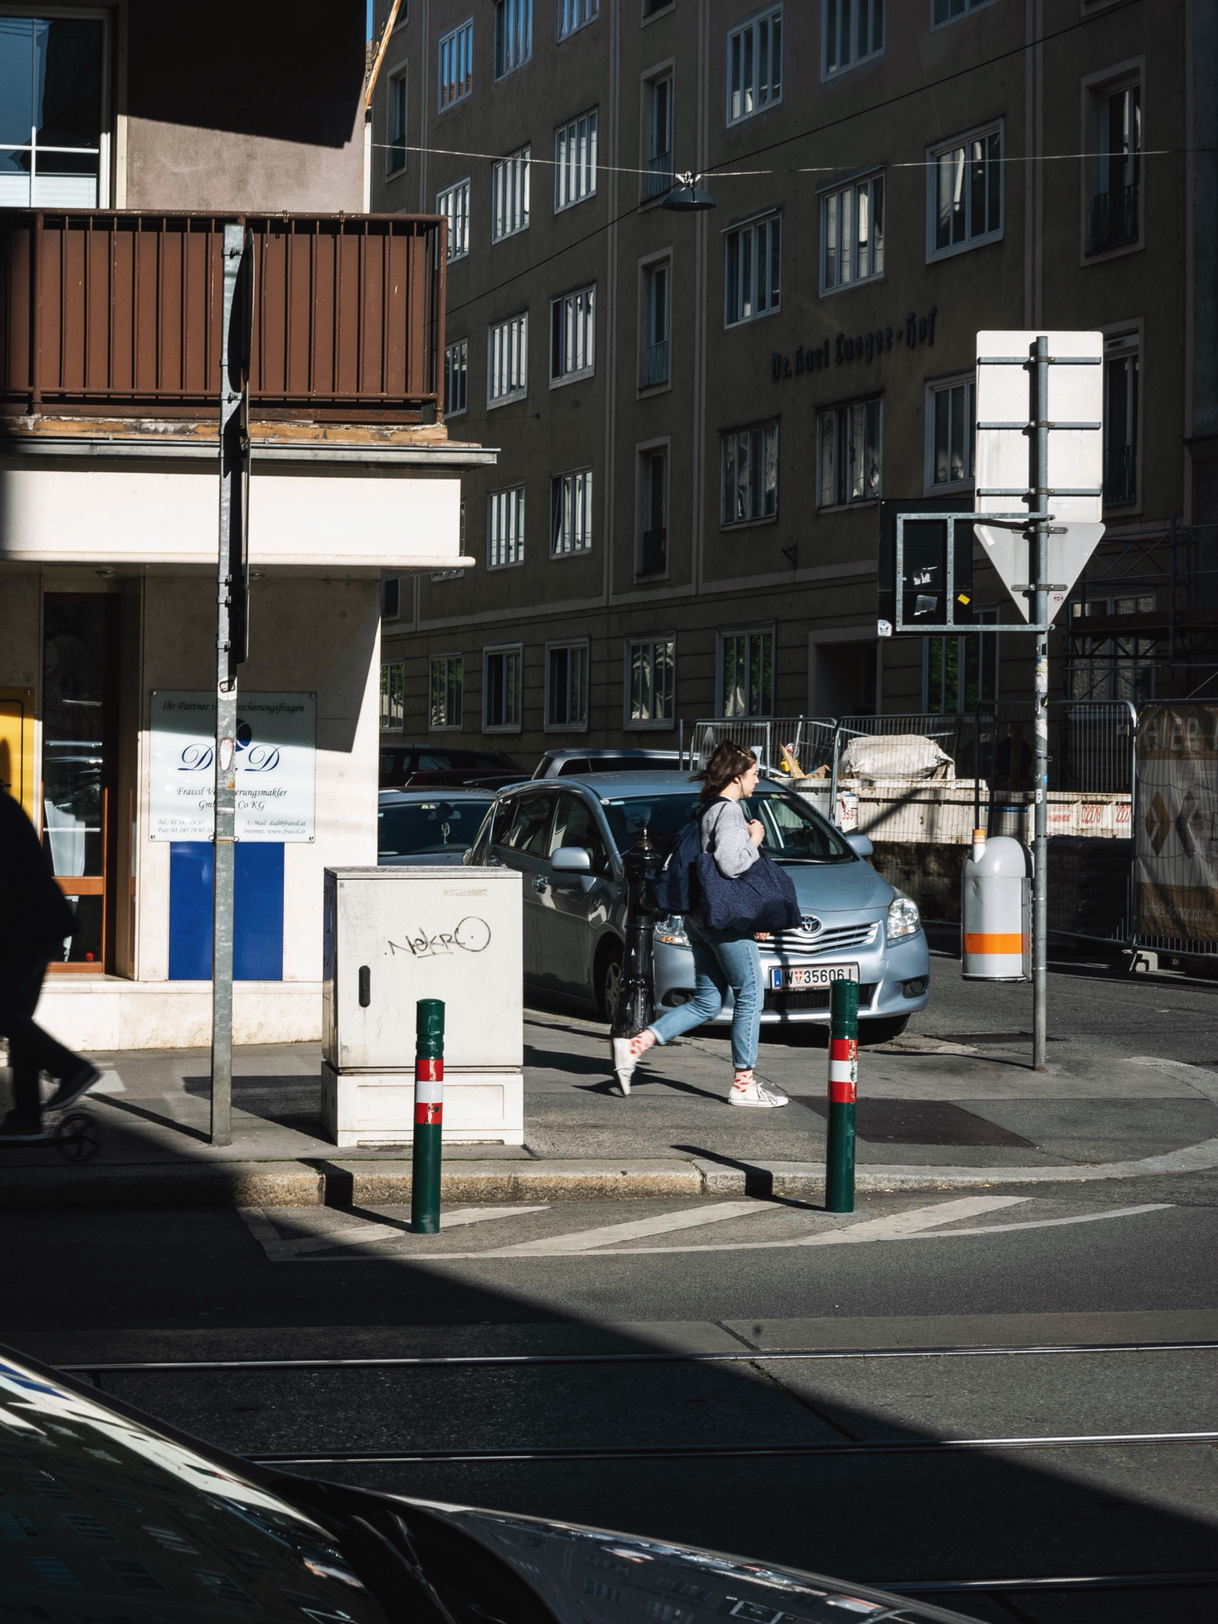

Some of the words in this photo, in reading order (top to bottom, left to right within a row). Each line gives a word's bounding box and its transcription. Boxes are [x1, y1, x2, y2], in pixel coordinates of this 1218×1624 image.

[163, 700, 177, 710] Ihr
[177, 701, 210, 711] Partner
[237, 701, 304, 715] sicherungsfragen
[176, 787, 204, 797] Fraissl
[237, 801, 249, 809] Co
[250, 801, 266, 811] KG
[784, 971, 793, 984] W
